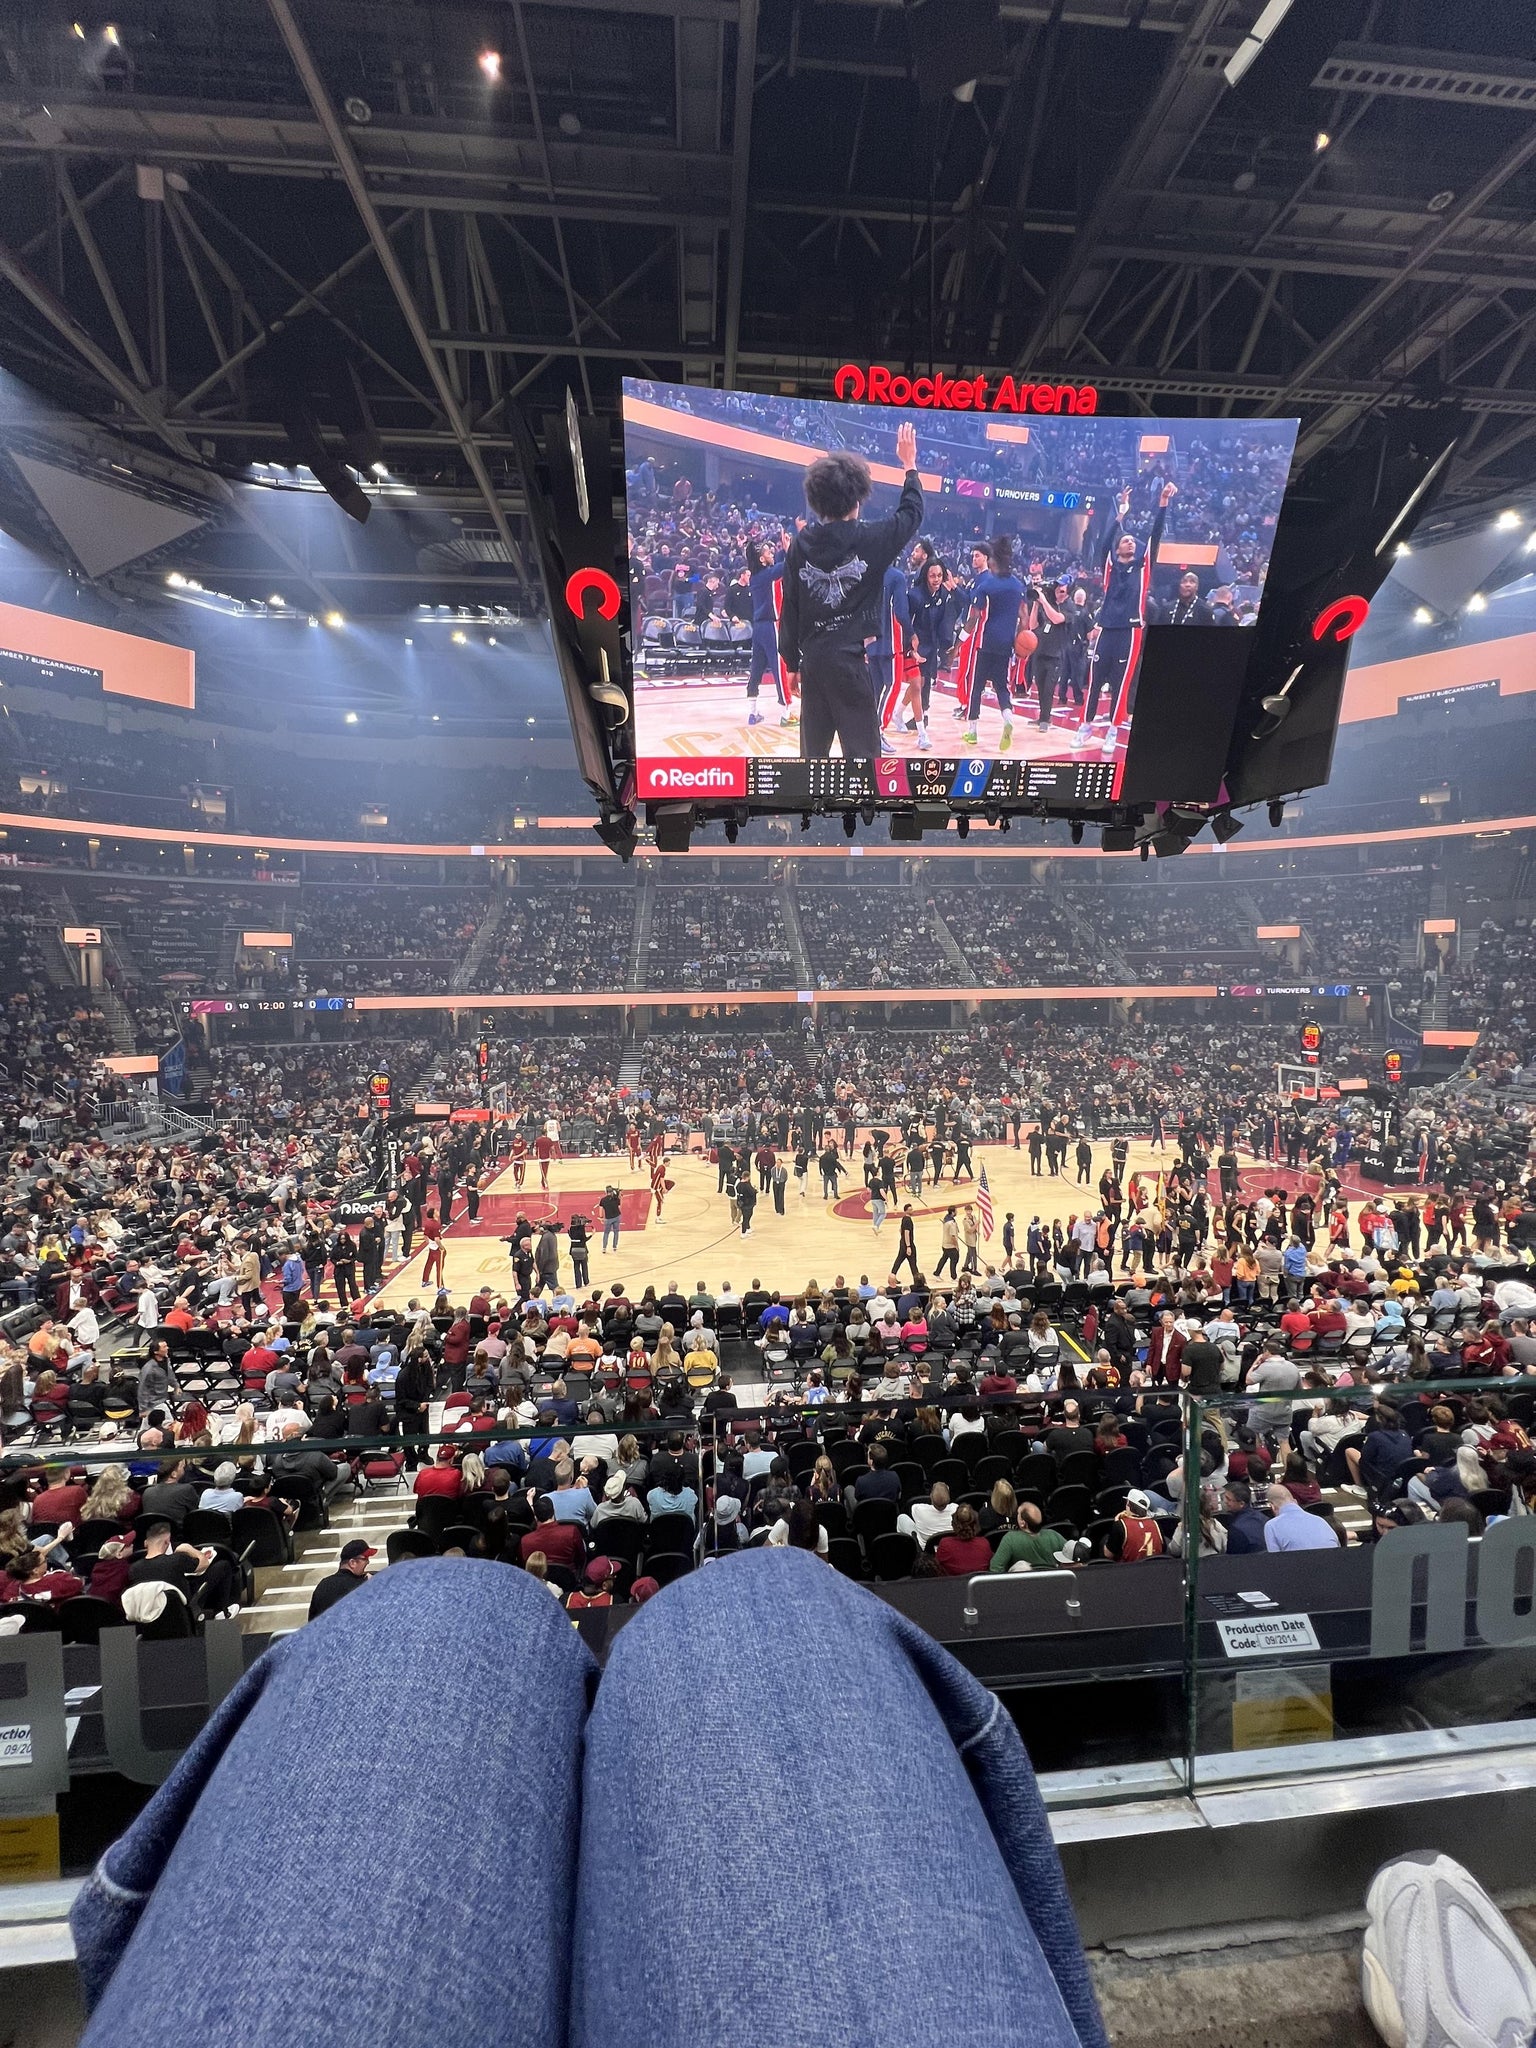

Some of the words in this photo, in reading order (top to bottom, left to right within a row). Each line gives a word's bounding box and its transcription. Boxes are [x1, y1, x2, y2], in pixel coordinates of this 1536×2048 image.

[868, 366, 988, 410] Rocket
[992, 375, 1097, 414] Arena
[984, 487, 990, 496] 0
[995, 488, 1040, 501] TURNOVERS
[1047, 494, 1054, 503] 0
[910, 763, 921, 771] 1Q
[944, 763, 954, 771] 24
[669, 767, 734, 787] Redfin
[888, 780, 897, 792] 0
[916, 784, 946, 795] 12:00
[964, 781, 973, 793] 0
[225, 1002, 232, 1011] 0
[258, 1002, 285, 1010] 12:00
[309, 1000, 316, 1009] 0
[632, 1356, 644, 1368] 10
[1138, 1532, 1156, 1556] 4
[1225, 1622, 1279, 1636] Production
[1282, 1620, 1306, 1631] Date
[1230, 1638, 1259, 1649] Code:
[1265, 1634, 1298, 1646] 09/2014
